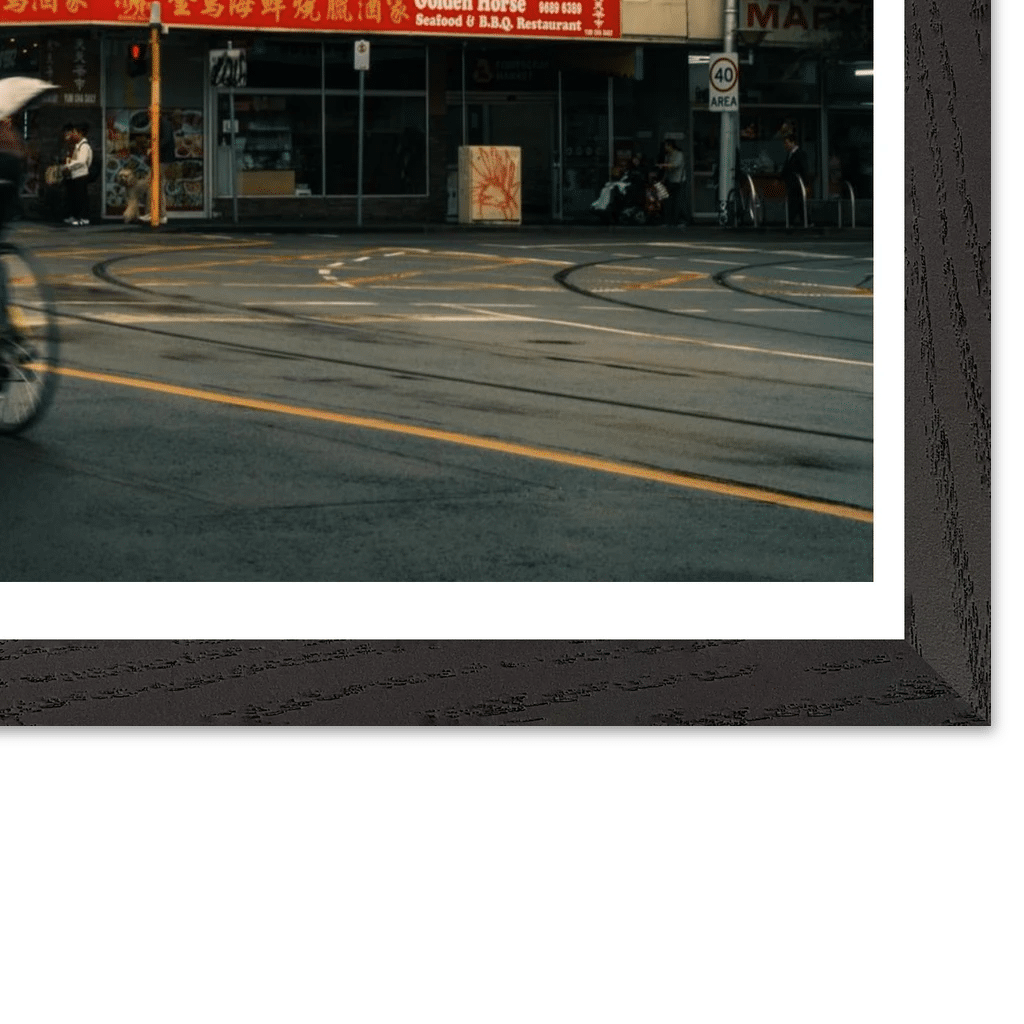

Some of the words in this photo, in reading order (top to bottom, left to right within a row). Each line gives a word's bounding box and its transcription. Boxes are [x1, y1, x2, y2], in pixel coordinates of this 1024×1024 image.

[415, 12, 463, 27] Seafood
[516, 16, 583, 32] Restaurant
[714, 66, 734, 83] 40
[711, 96, 737, 108] AREA
